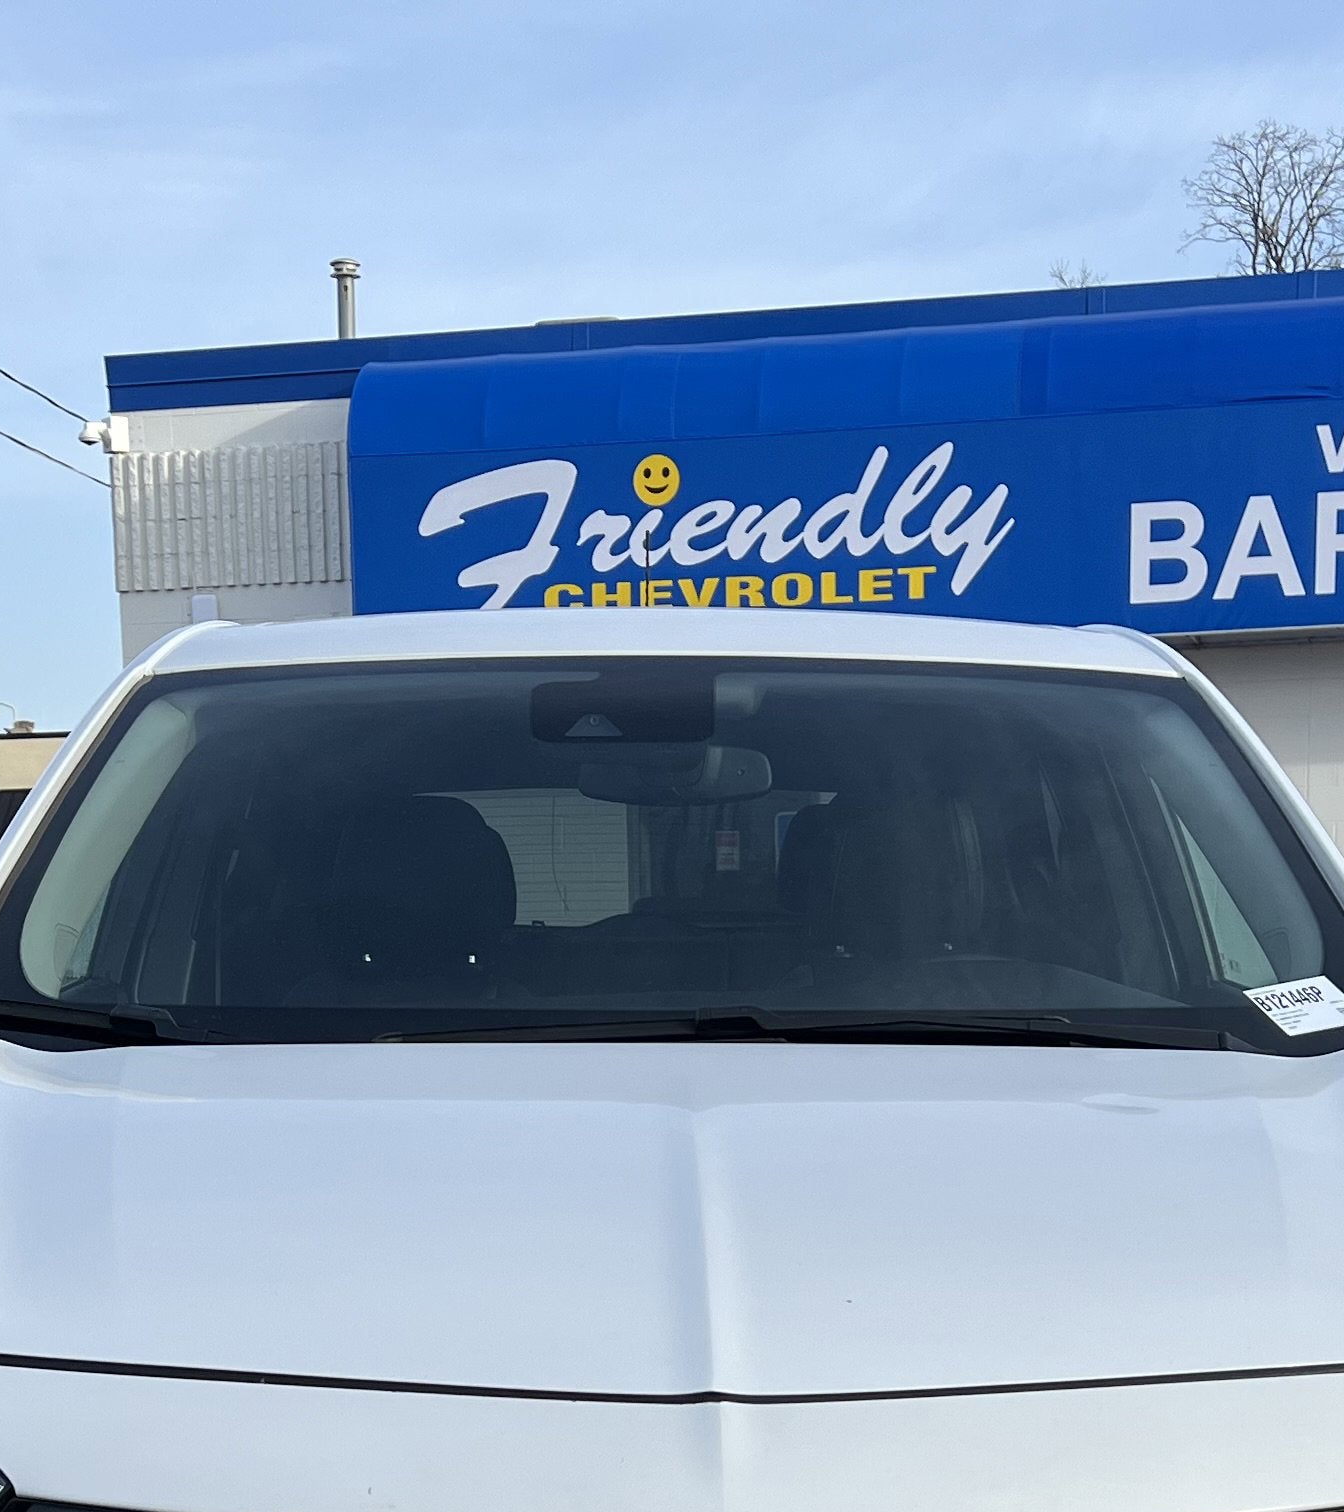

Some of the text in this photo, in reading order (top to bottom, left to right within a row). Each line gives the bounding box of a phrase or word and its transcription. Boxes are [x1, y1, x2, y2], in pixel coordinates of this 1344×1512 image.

[418, 441, 1015, 609] Friendly
[543, 566, 937, 608] CHEVROLET
[1253, 985, 1325, 1012] B121446P
